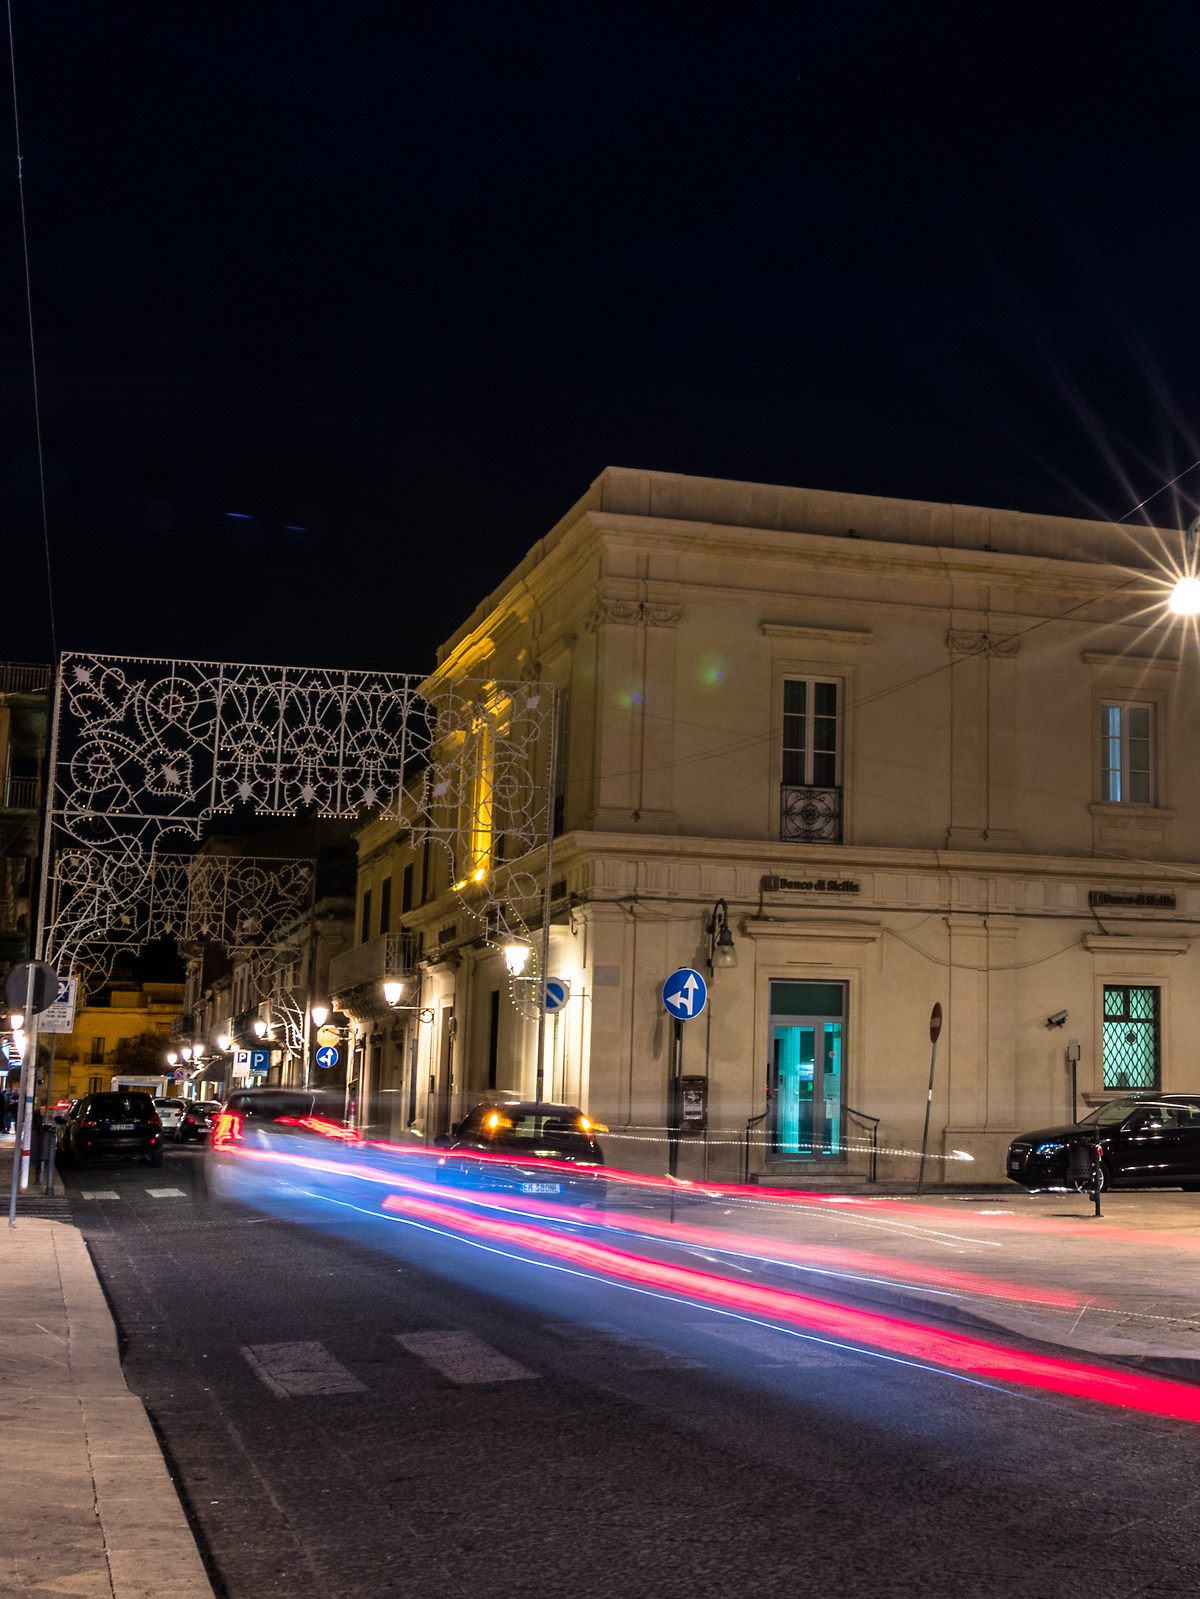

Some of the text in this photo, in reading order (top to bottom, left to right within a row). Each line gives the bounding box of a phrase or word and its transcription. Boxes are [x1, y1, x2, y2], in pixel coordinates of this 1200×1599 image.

[780, 878, 860, 892] Banco di Sicilia
[1103, 894, 1134, 904] Banco
[239, 1052, 247, 1063] P
[254, 1053, 264, 1067] P
